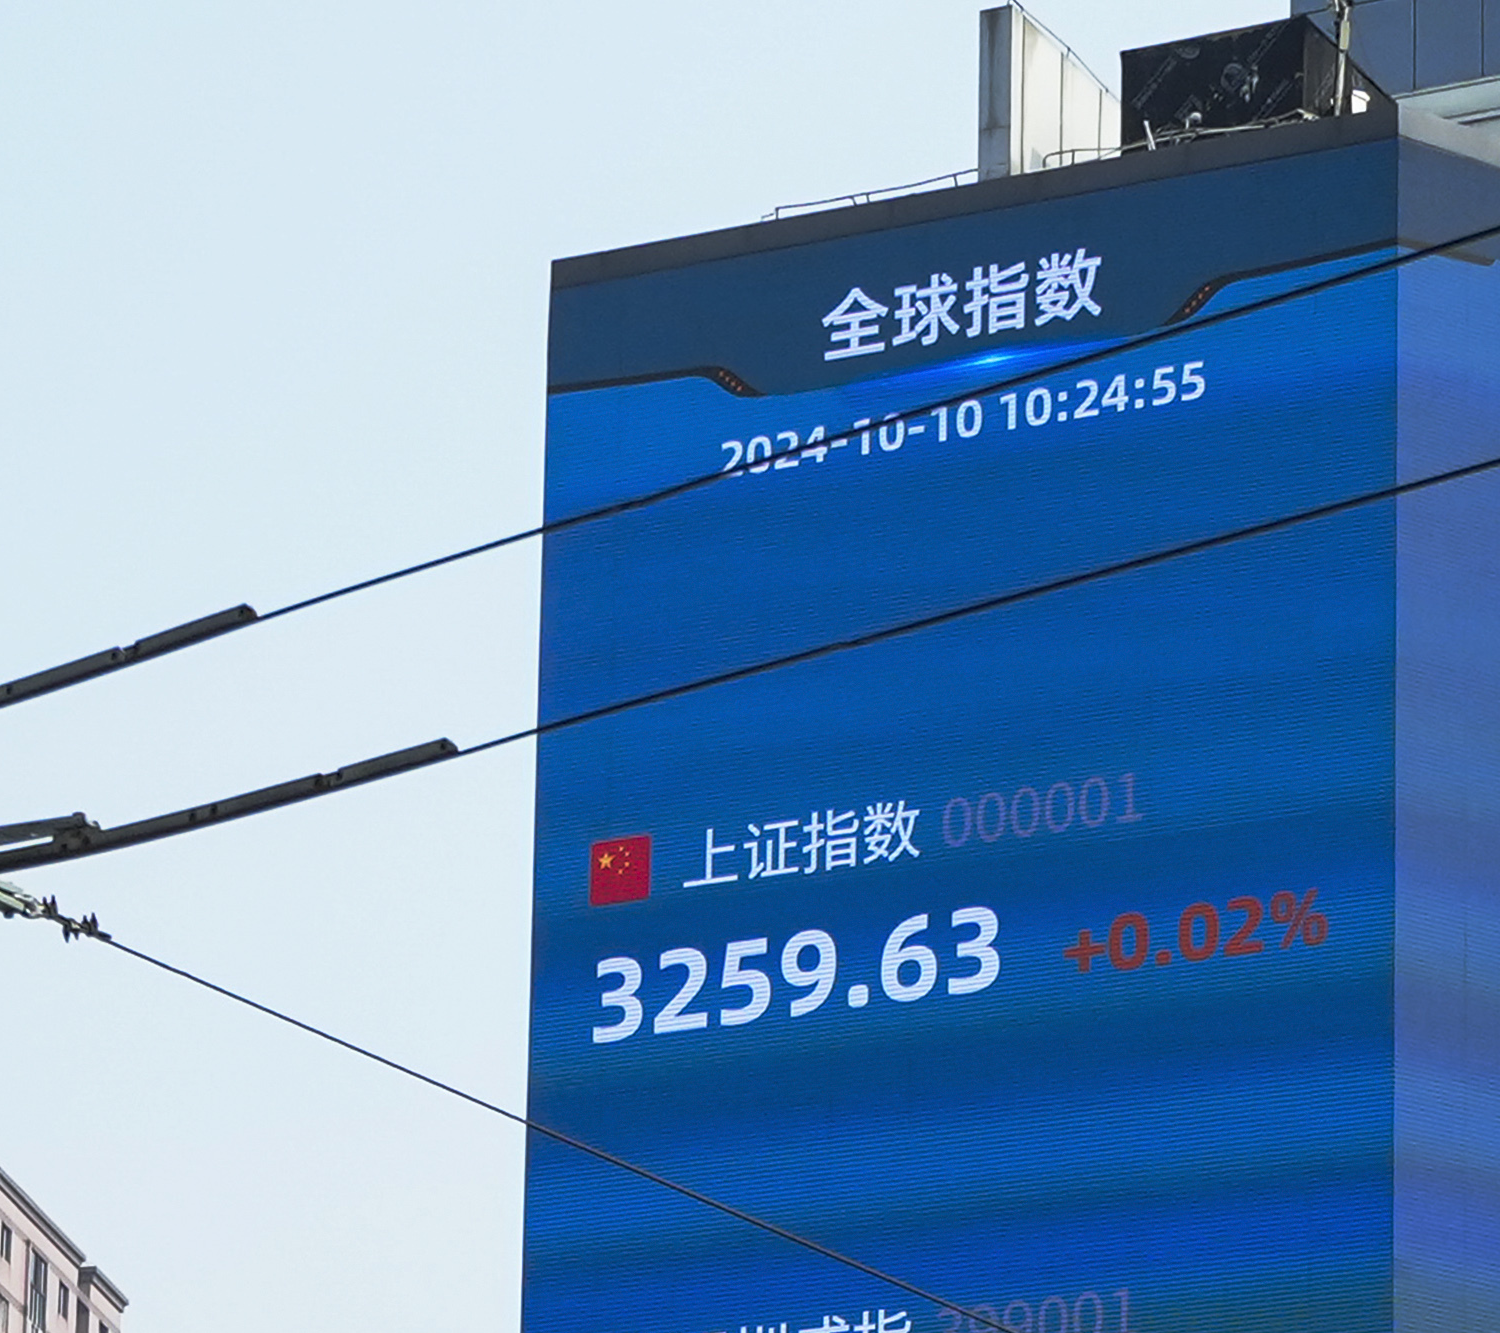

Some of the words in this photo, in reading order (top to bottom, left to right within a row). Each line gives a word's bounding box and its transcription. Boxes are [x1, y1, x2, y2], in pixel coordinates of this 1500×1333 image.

[821, 248, 1102, 362] 全球指数
[720, 401, 984, 478] 2024-10-10
[999, 361, 1207, 433] 10:24:55
[683, 800, 921, 888] 上证指数
[941, 773, 1143, 847] 000001
[591, 904, 1001, 1044] 3259.63
[1062, 888, 1329, 974] +0.02%
